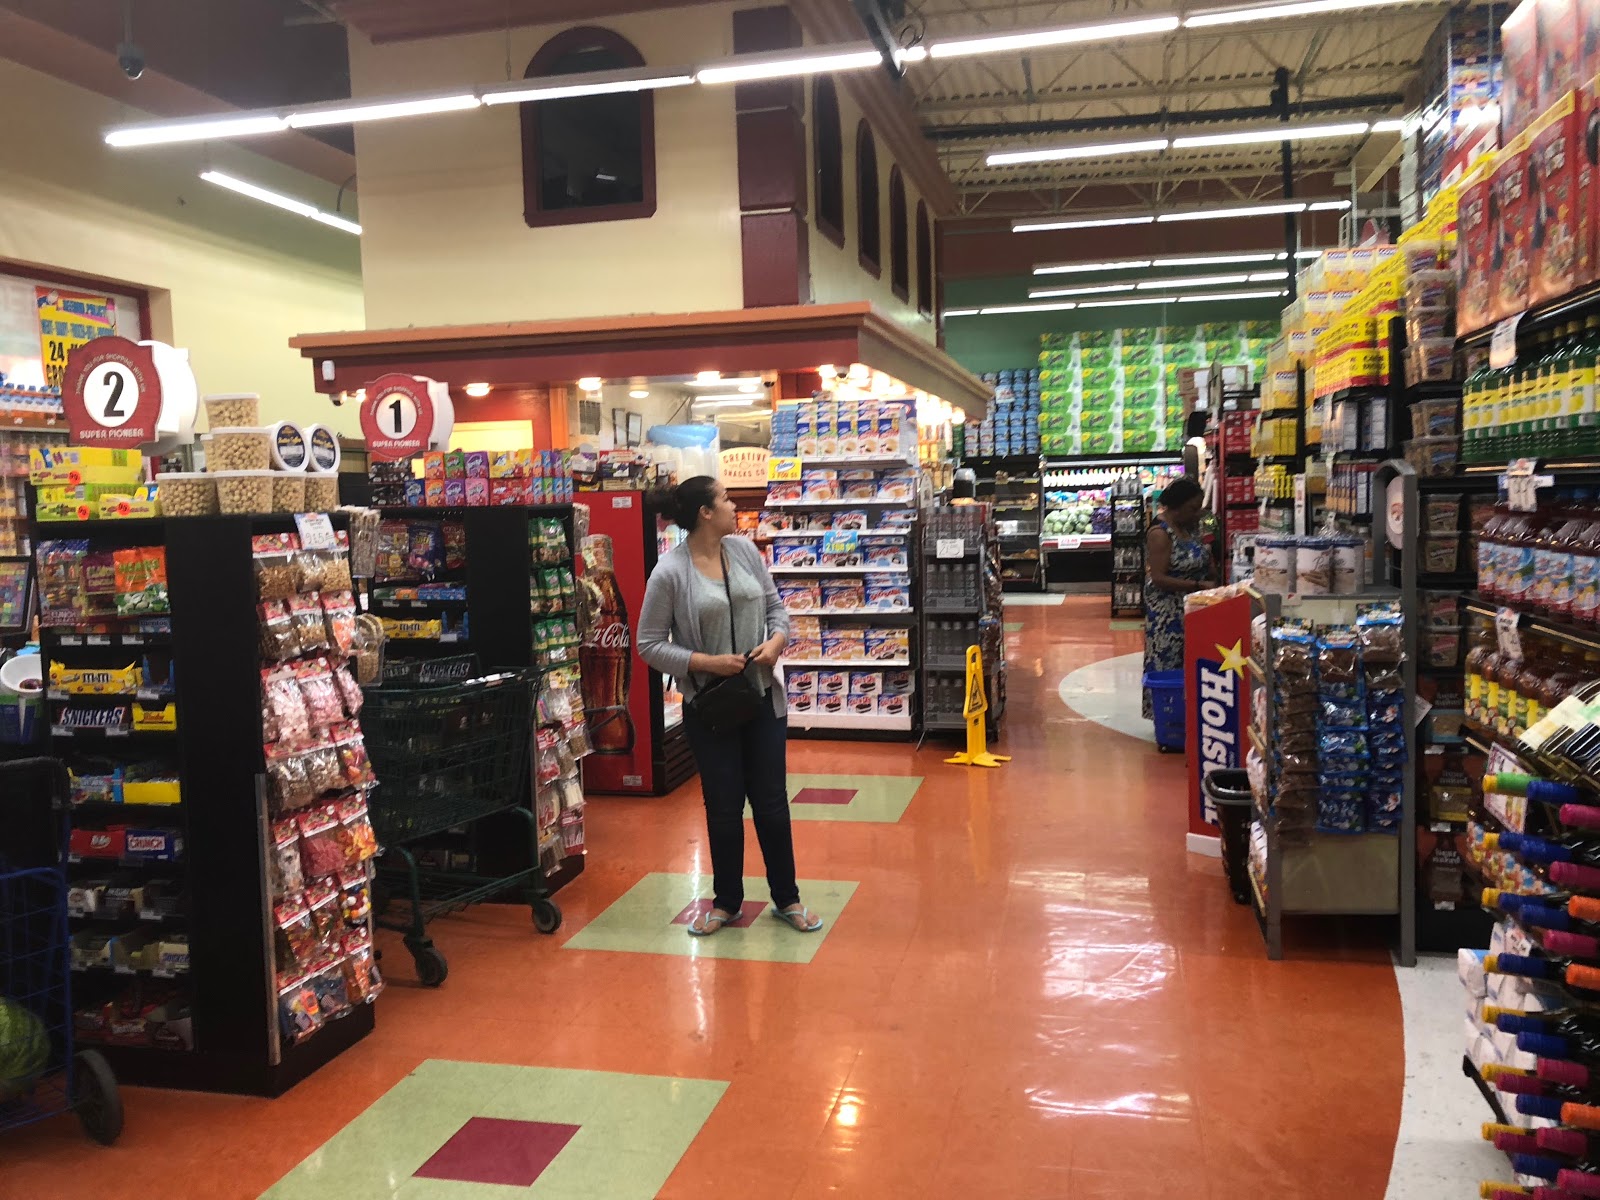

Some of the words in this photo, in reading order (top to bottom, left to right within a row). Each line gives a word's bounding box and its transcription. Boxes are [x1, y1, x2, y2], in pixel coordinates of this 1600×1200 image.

[49, 340, 65, 362] 24
[103, 371, 125, 417] 2
[389, 399, 402, 433] 1
[80, 429, 107, 439] SUPER
[108, 428, 144, 438] PIONEER
[372, 440, 393, 448] SUPER
[722, 452, 767, 464] CREATIVE
[723, 469, 752, 477] SNACKS
[60, 707, 125, 727] SNICKERS
[1200, 666, 1236, 825] Hols
[130, 837, 165, 850] CRUNCH
